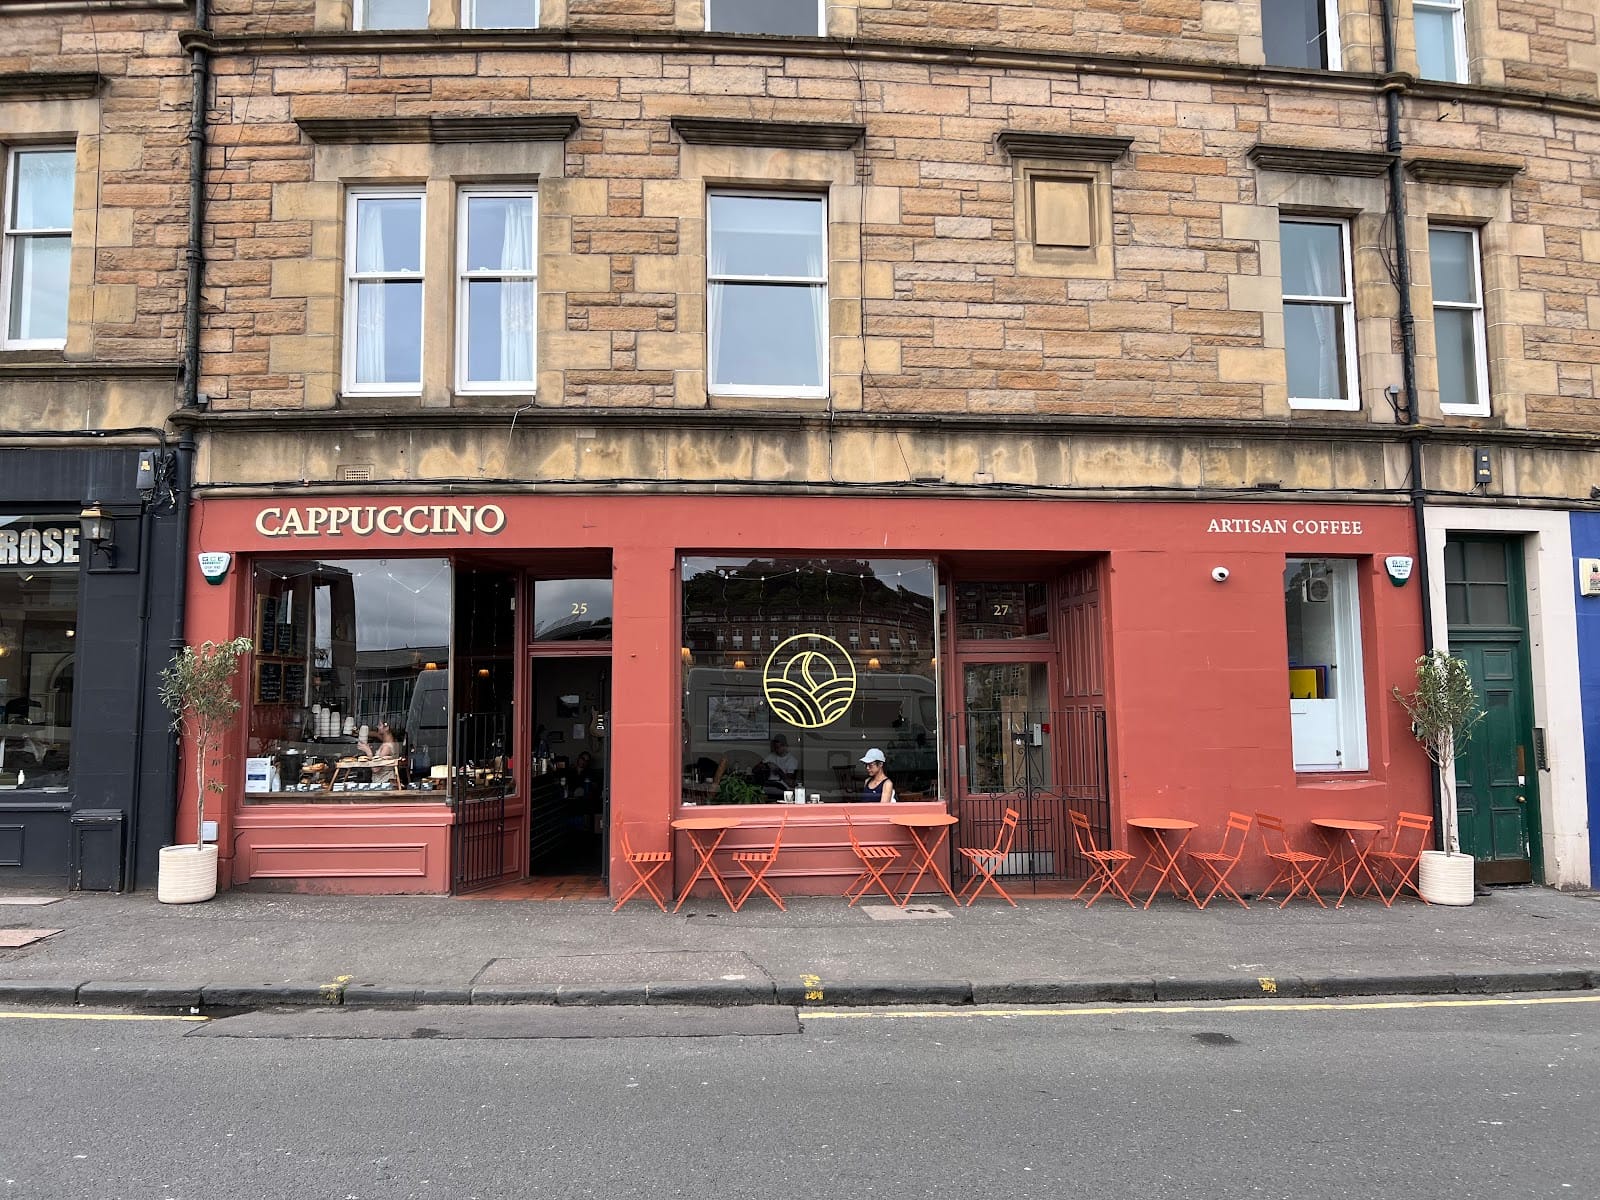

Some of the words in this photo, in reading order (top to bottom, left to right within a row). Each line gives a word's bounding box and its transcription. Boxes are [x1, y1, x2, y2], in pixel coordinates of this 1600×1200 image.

[254, 504, 507, 537] CAPPUCCINO
[1207, 518, 1288, 534] ARTISAN
[1292, 520, 1363, 535] COFFEE
[0, 528, 80, 564] ROSE
[571, 602, 588, 615] 25
[993, 604, 1009, 616] 27
